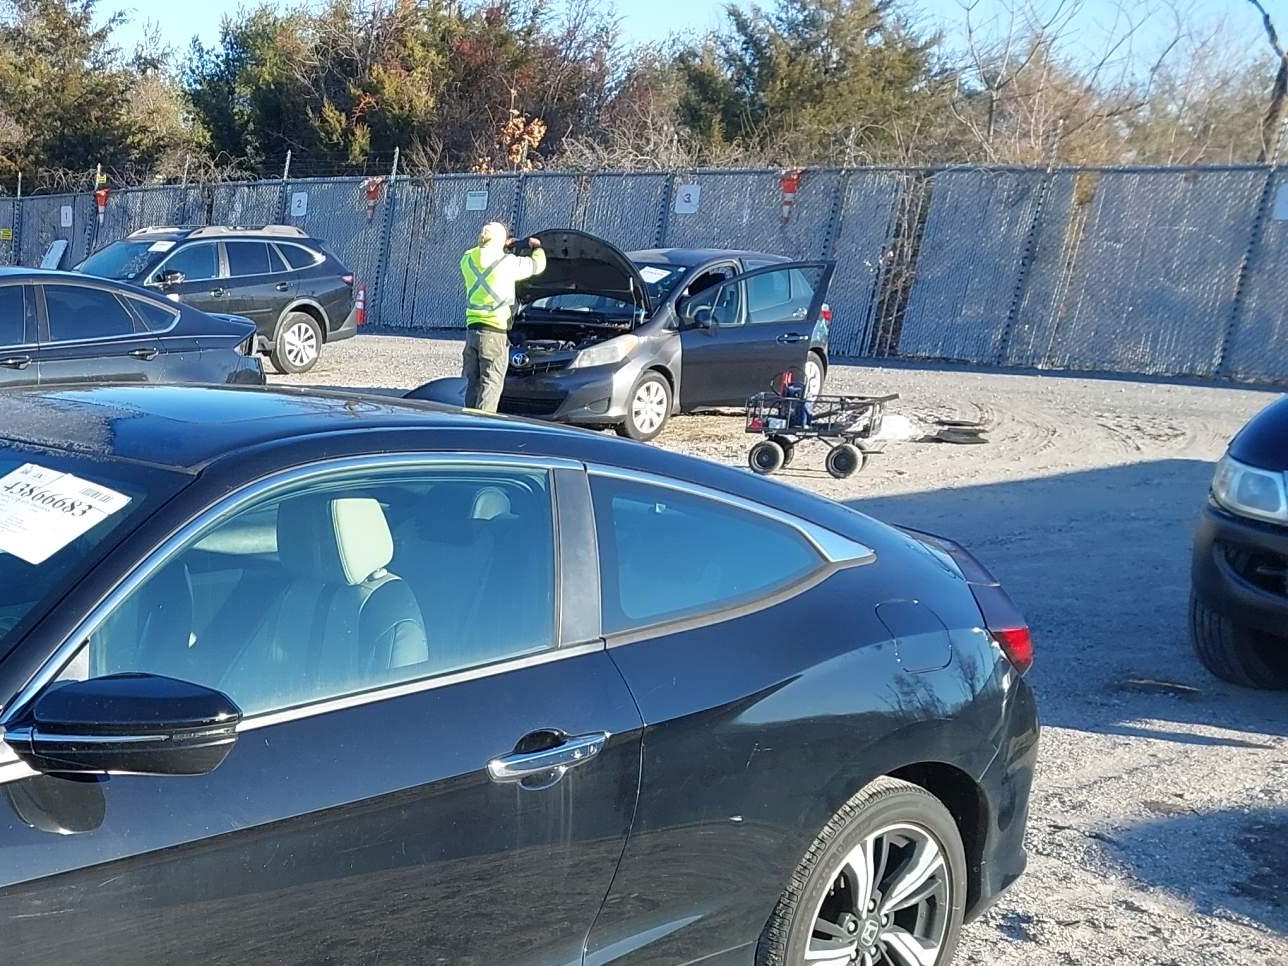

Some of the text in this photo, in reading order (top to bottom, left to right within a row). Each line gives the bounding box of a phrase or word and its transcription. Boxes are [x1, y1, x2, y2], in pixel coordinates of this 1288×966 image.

[684, 193, 691, 203] 3
[296, 199, 302, 208] 2
[4, 481, 93, 516] 43866683
